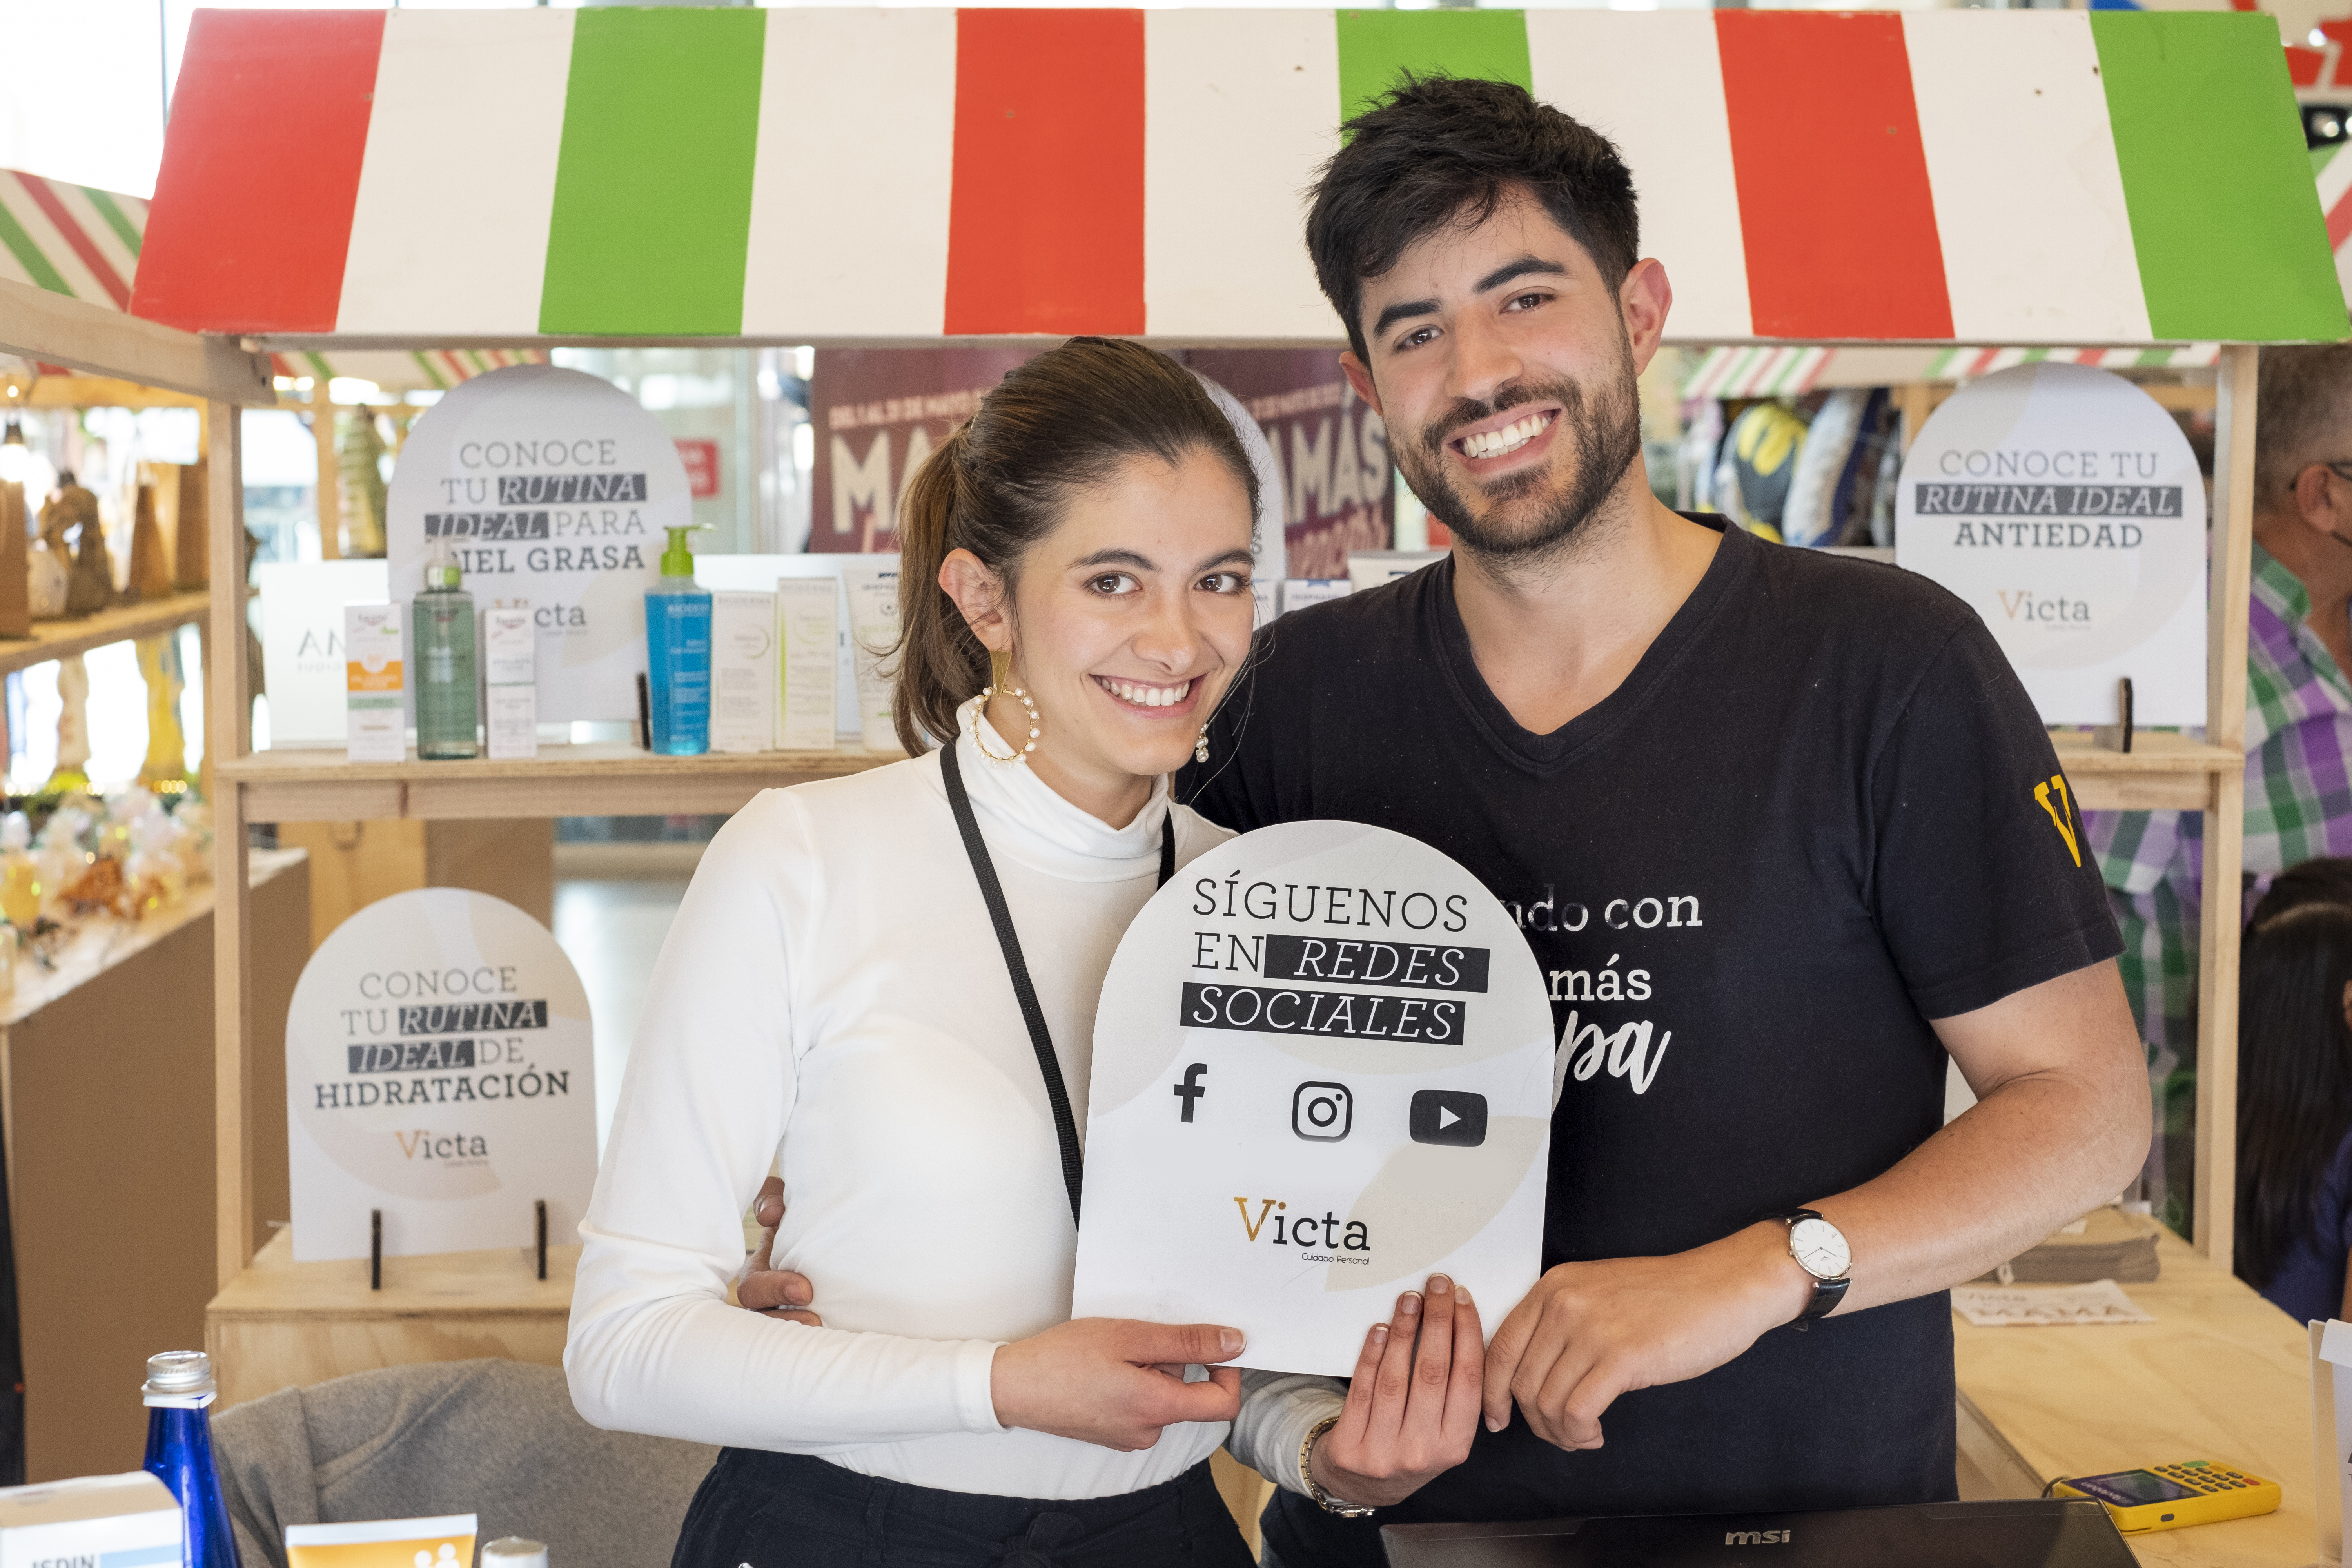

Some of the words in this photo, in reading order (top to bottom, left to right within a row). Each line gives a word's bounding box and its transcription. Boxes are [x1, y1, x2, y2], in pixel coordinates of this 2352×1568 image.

[460, 439, 616, 469] CONOCE
[1940, 449, 2098, 479] CONOCE
[2110, 452, 2158, 479] TU
[441, 477, 487, 505] TU
[500, 474, 638, 503] RUTINA
[1922, 485, 2058, 514] RUTINA
[2069, 486, 2174, 516] IDEAL
[437, 511, 543, 539] IDEAL
[555, 509, 646, 537] PARA
[1954, 522, 2142, 548] ANTIEDAD
[451, 549, 515, 574] IEL
[527, 545, 645, 572] GRASA
[1998, 589, 2091, 622] Victa
[1193, 869, 1467, 932] SÍGUENOS
[1604, 895, 1702, 929] con
[1192, 932, 1265, 973] EN
[1293, 939, 1464, 986] REDES
[359, 966, 517, 1000] CONOCE
[1549, 953, 1651, 1001] más
[340, 1007, 388, 1036] TU
[401, 999, 540, 1034] RUTINA
[1193, 986, 1456, 1040] SOCIALES
[356, 1040, 467, 1072] IDEAL
[479, 1037, 524, 1065] DE
[314, 1063, 570, 1109] HIDRATACIÓN
[394, 1129, 488, 1160] Victa
[1234, 1197, 1370, 1251] Victa
[1301, 1252, 1334, 1262] Cuidado
[1337, 1255, 1369, 1265] Personal
[1725, 1530, 1791, 1545] msi
